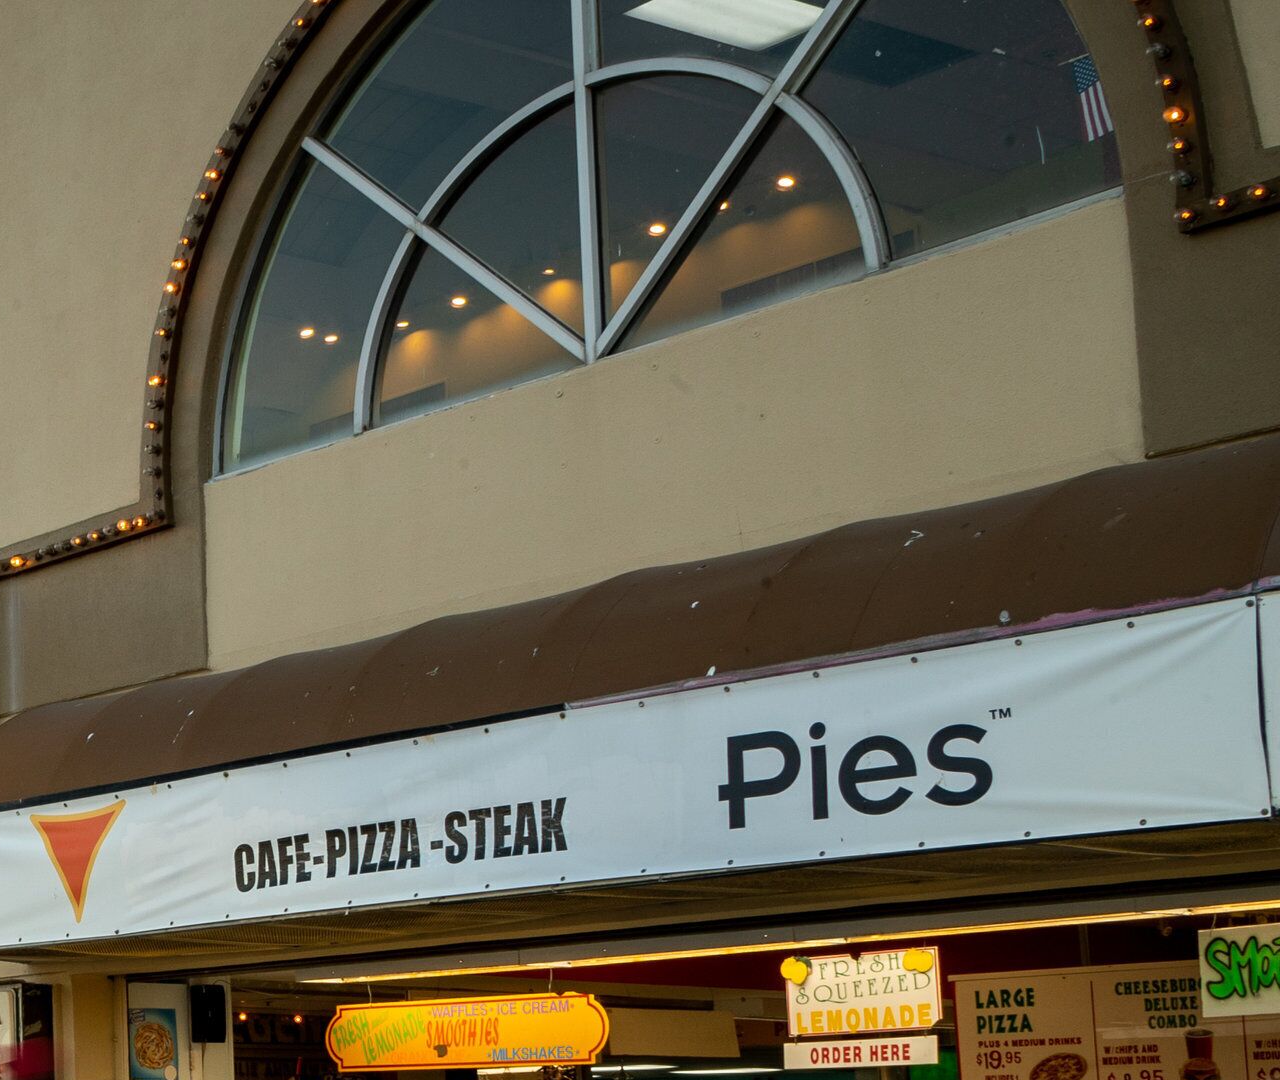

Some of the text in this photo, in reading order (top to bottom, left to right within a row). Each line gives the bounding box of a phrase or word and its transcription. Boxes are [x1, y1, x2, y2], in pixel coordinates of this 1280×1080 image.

[718, 722, 994, 830] Pies
[818, 953, 900, 980] FRESH
[1205, 936, 1280, 999] SMO
[796, 973, 931, 1005] SQUEEZED
[1114, 978, 1201, 996] CHEESEBUR
[974, 987, 1035, 1009] LARGE
[1144, 996, 1198, 1012] DELUXE
[431, 1000, 570, 1018] WAFFLES ICE CREAM
[796, 1003, 932, 1033] LEMONADE
[976, 1014, 1033, 1035] PIZZA
[1148, 1014, 1197, 1029] COMBO
[426, 1017, 500, 1048] SMOOTHIES
[978, 1040, 1000, 1048] PLUS
[1011, 1038, 1046, 1047] MEDIUM
[1048, 1037, 1082, 1046] DRINKS
[492, 1045, 574, 1061] MILKSHAKES
[811, 1044, 911, 1064] ORDER HERE
[1140, 1044, 1158, 1053] AND
[976, 1050, 1022, 1070] $19.95
[1102, 1055, 1162, 1066] MEDIUM DRINK
